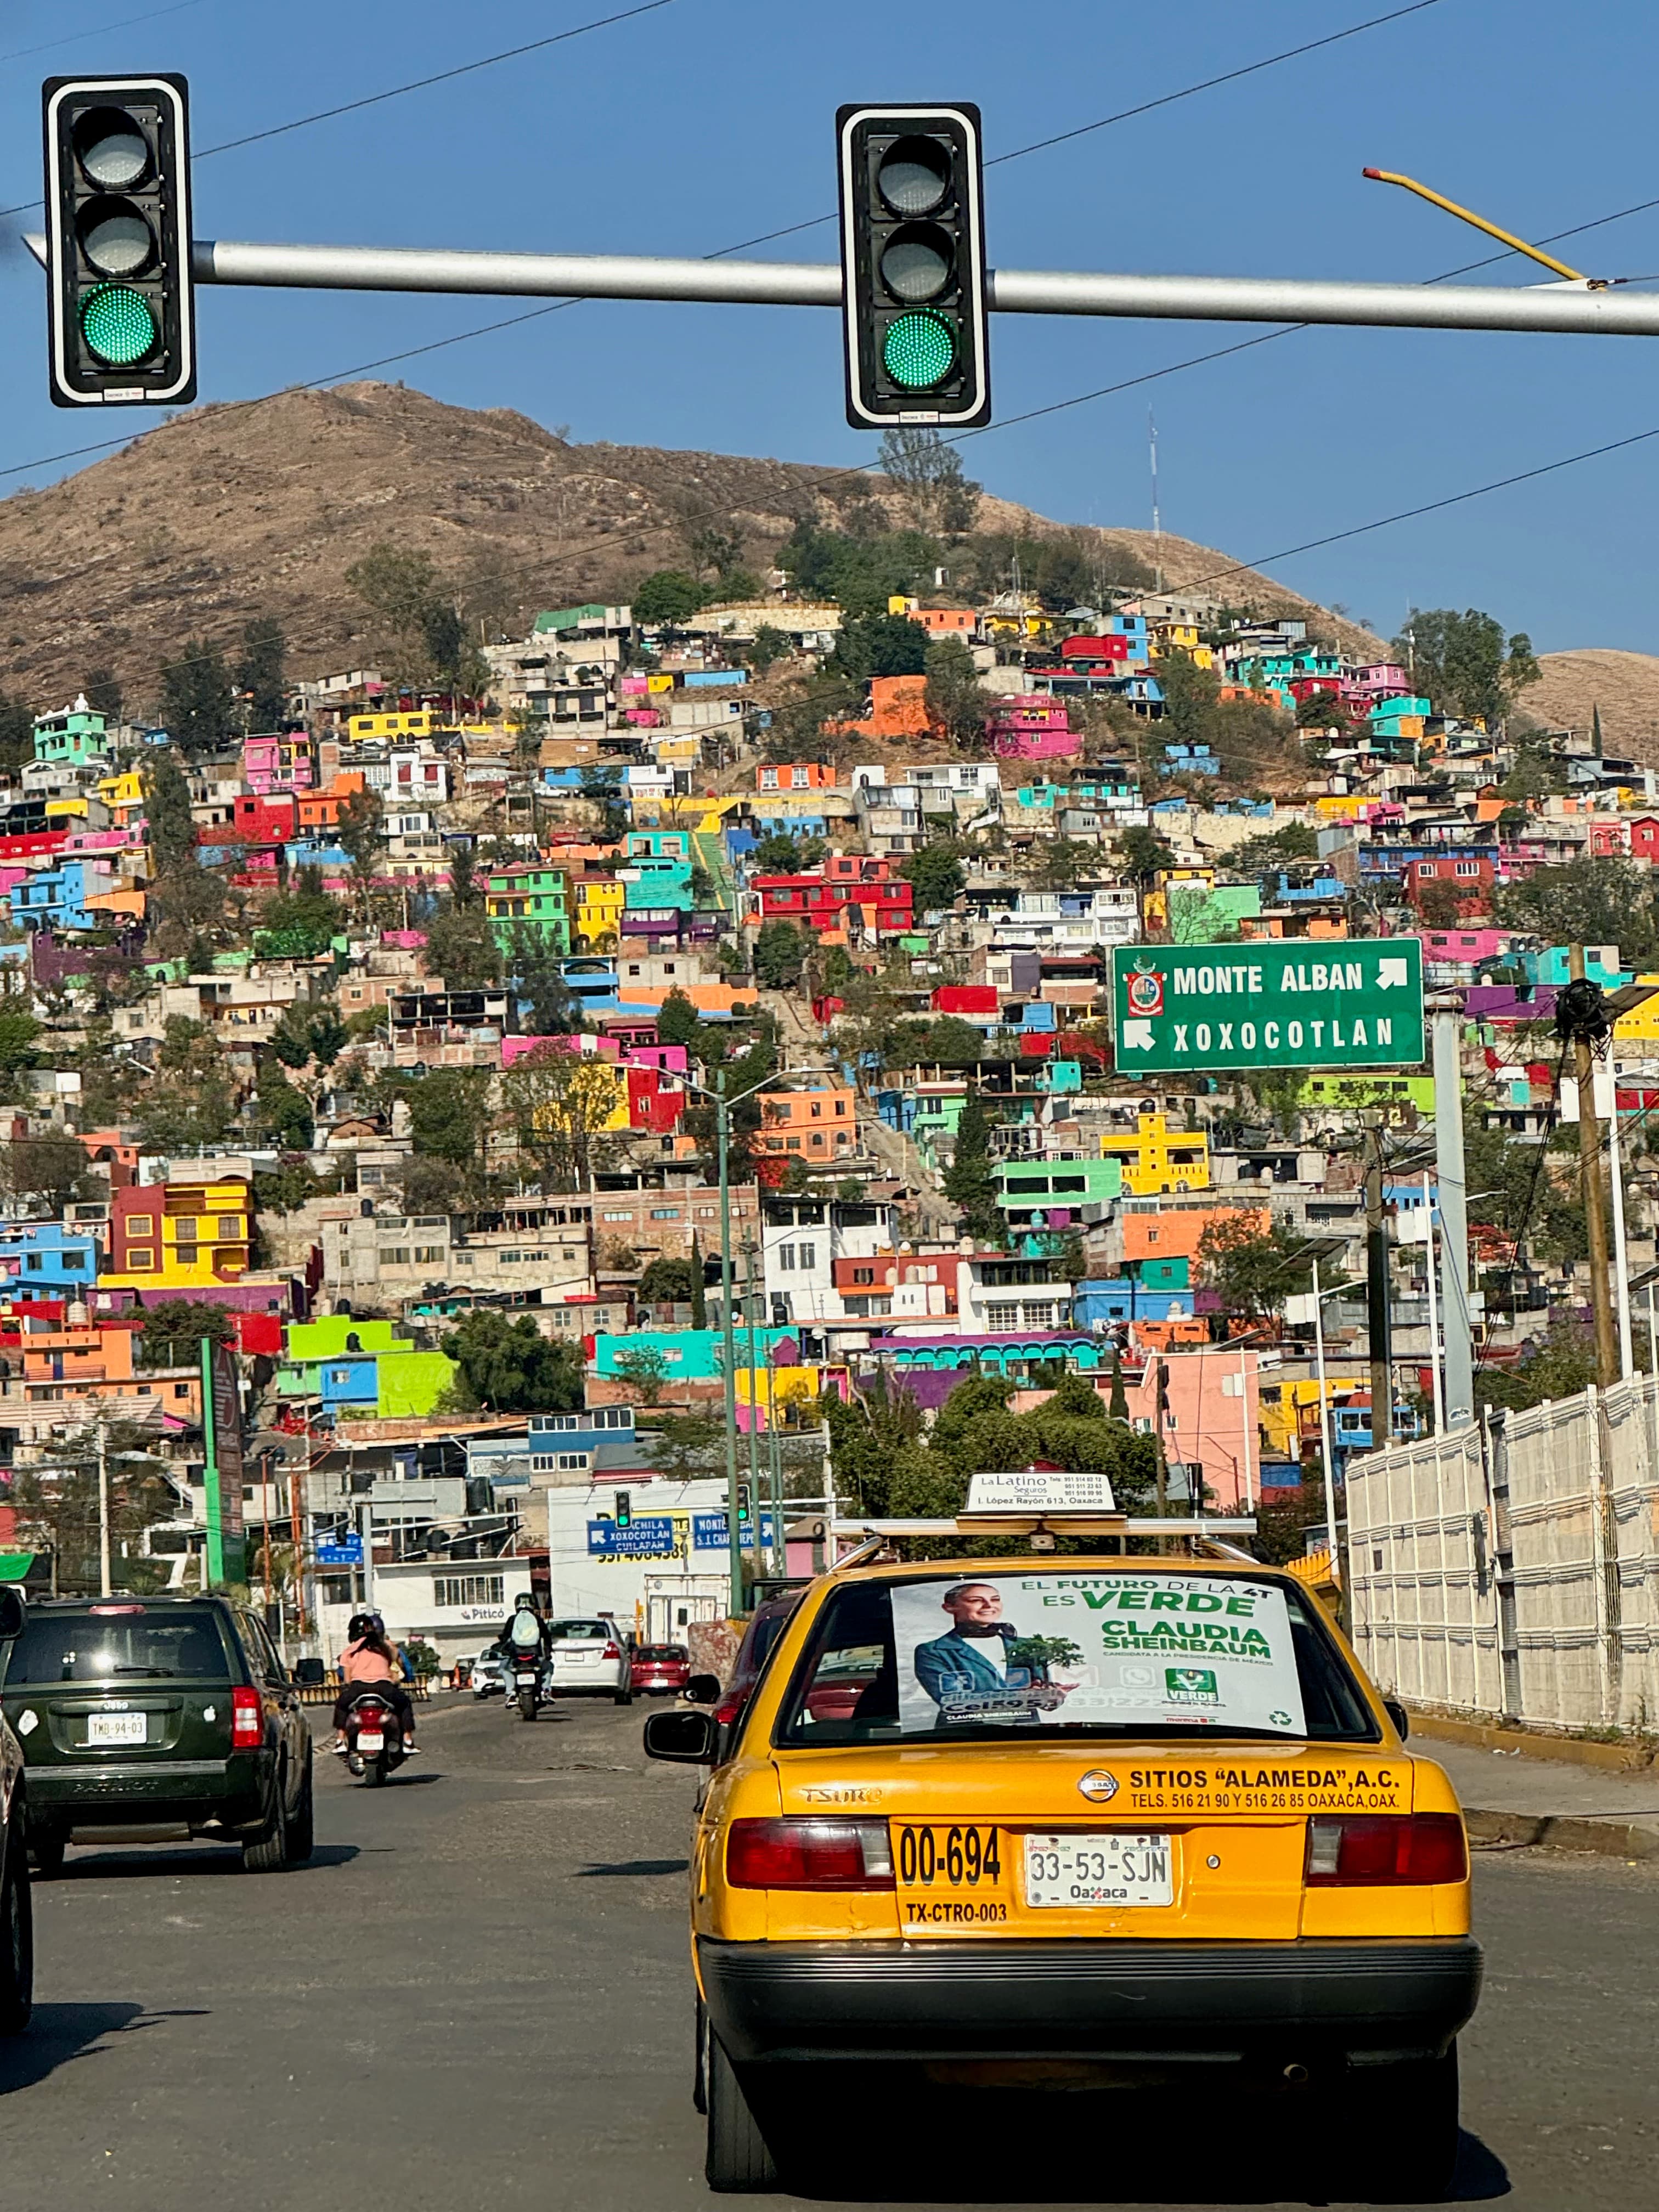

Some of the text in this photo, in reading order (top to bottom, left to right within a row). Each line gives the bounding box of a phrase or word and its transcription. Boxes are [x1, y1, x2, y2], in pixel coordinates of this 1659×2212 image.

[1174, 963, 1362, 994] MONTE ALBAN
[1174, 1018, 1391, 1051] XOXOCOTLAN
[997, 1475, 1047, 1486] Latino
[1014, 1486, 1047, 1496] Seguros
[611, 1531, 669, 1541] XOXOCOTLAN
[1022, 1579, 1273, 1599] EL FUTURO DE LA 4T
[1043, 1590, 1255, 1617] ES VERDE
[1102, 1620, 1269, 1646] CLAUDIA
[1103, 1637, 1271, 1658] SHEINBAUM
[1173, 1653, 1227, 1661] PRESIDENCIA
[1169, 1690, 1217, 1701] VERDE
[1130, 1770, 1207, 1788] SITIOS
[1131, 1793, 1167, 1807] TELS.
[1172, 1793, 1193, 1807] 516
[1197, 1793, 1210, 1807] 21
[1215, 1793, 1229, 1807] 90
[1233, 1793, 1242, 1807] Y
[1245, 1793, 1267, 1807] 516
[1272, 1793, 1286, 1807] 26
[1290, 1793, 1304, 1807] 85
[900, 1826, 1000, 1886] 00-694
[1031, 1852, 1166, 1882] 33-53-SJN
[1070, 1885, 1128, 1899] Oaxaca
[906, 1903, 1007, 1922] TX-CTRO-003
